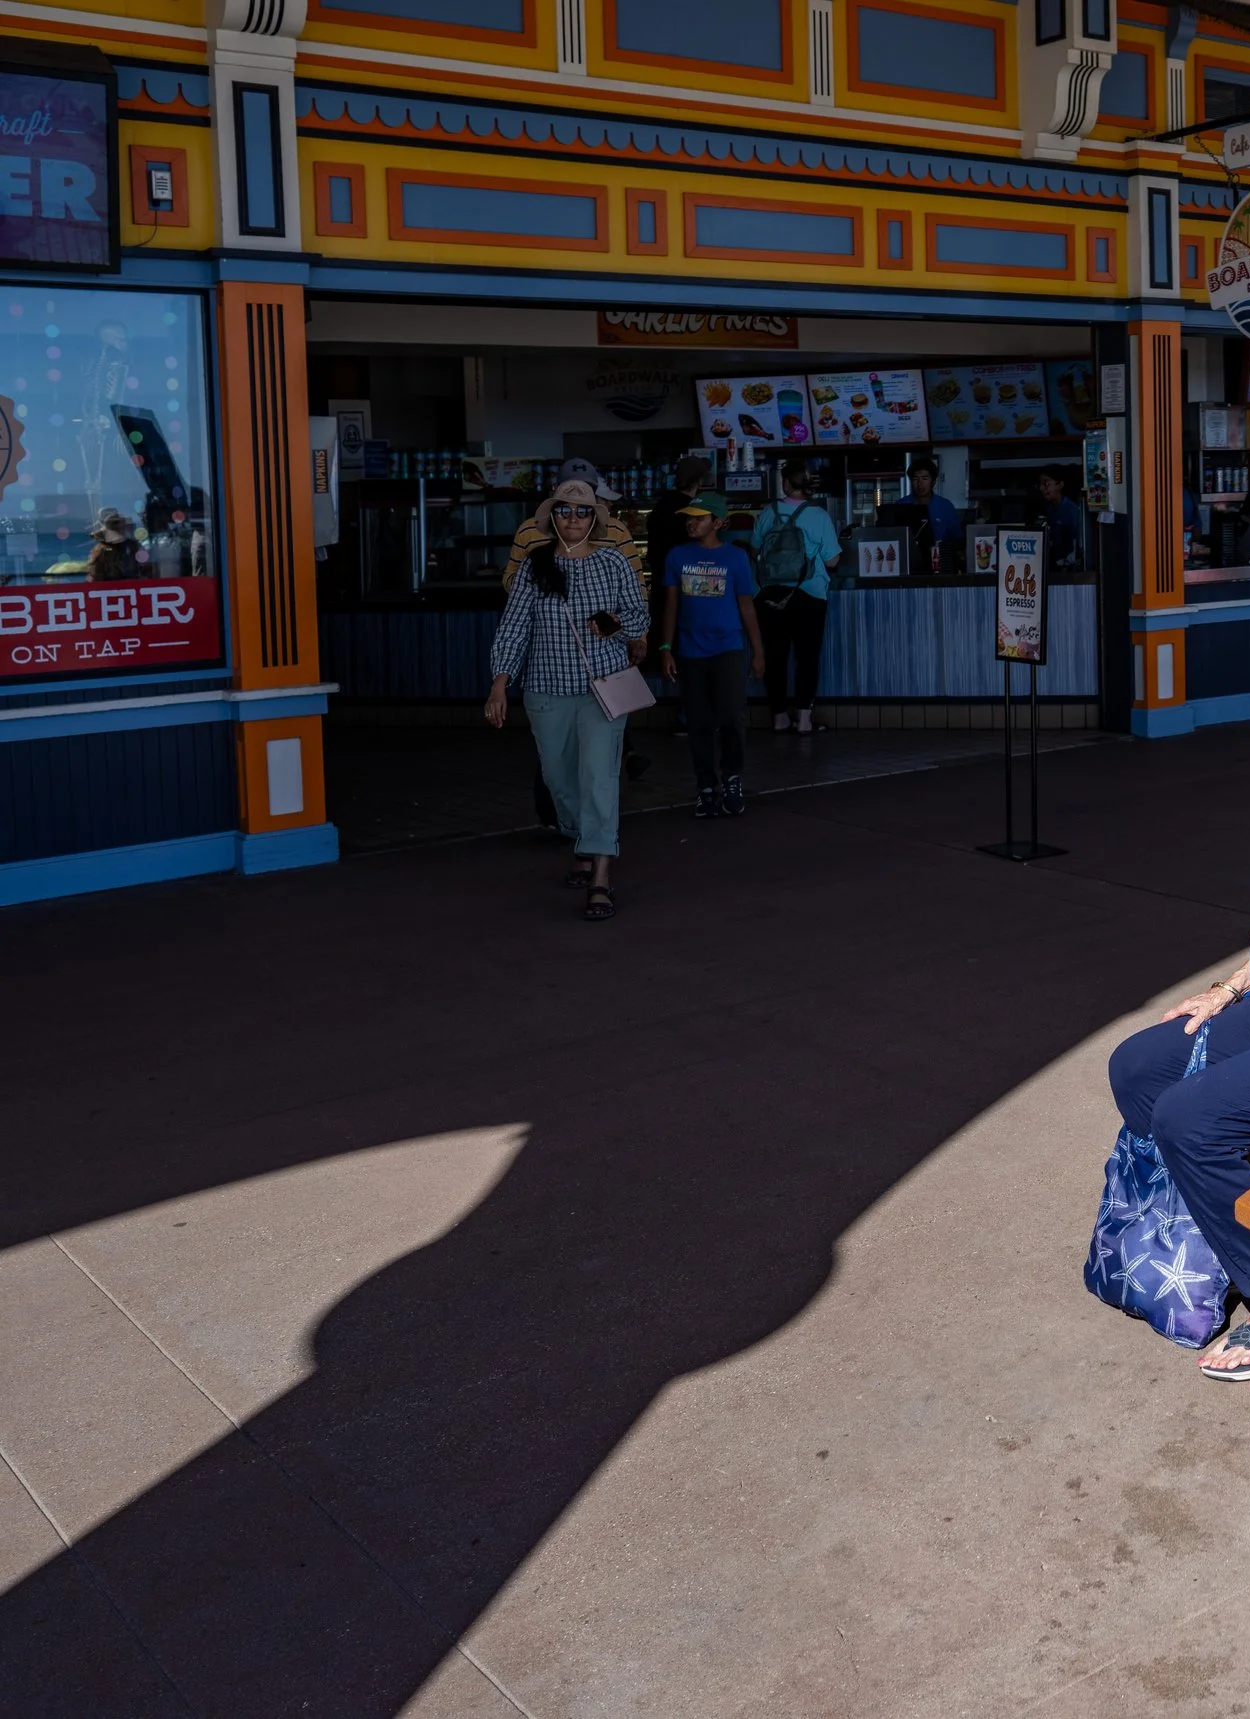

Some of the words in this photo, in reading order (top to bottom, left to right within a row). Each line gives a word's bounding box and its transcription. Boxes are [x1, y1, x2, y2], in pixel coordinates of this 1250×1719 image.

[314, 450, 327, 493] NAPKINS
[1011, 540, 1032, 552] OPEN
[681, 564, 728, 576] MANDALORIAN
[1004, 563, 1037, 599] Café
[0, 585, 195, 636] BEER
[1006, 597, 1036, 609] ESPRESSO
[11, 644, 61, 664] ON
[75, 637, 142, 660] TAP
